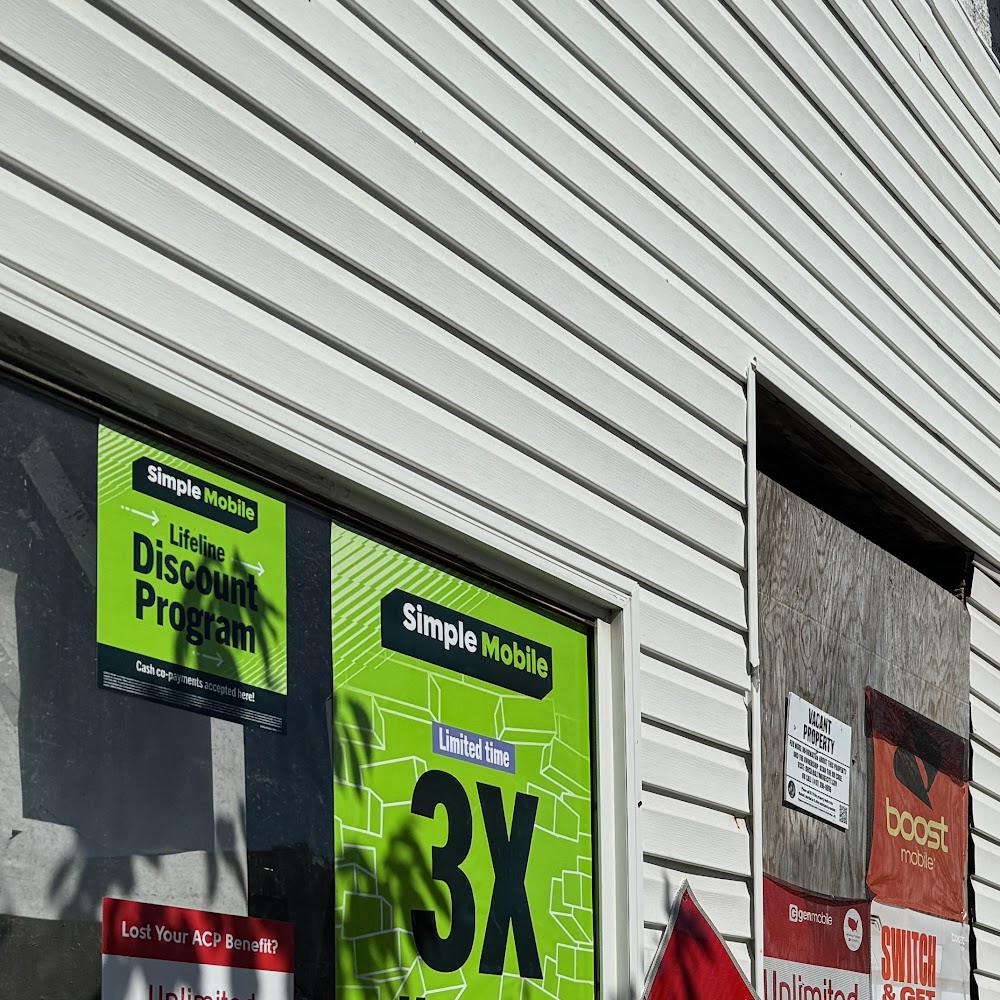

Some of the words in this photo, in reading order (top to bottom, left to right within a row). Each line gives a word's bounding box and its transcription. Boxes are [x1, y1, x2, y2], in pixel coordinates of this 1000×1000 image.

[147, 464, 202, 500] Simple
[203, 487, 255, 521] Mobile
[169, 522, 225, 563] Lifeline
[132, 530, 259, 612] Discount
[135, 578, 256, 654] Program
[402, 601, 478, 653] Simple
[481, 631, 549, 679] Mobile
[136, 660, 155, 675] Cash
[156, 665, 204, 689] co-payments
[204, 680, 237, 698] accepted
[803, 723, 836, 755] PROPERTY
[808, 707, 833, 736] VACANT
[438, 726, 483, 761] Limited
[484, 741, 510, 768] time
[885, 797, 949, 853] boost
[410, 768, 544, 981] 3X
[900, 848, 935, 870] mobile
[121, 920, 152, 939] Lost
[155, 925, 189, 944] Your
[192, 930, 222, 948] ACP
[225, 934, 279, 955] Benefit?
[881, 925, 936, 987] SWITCH
